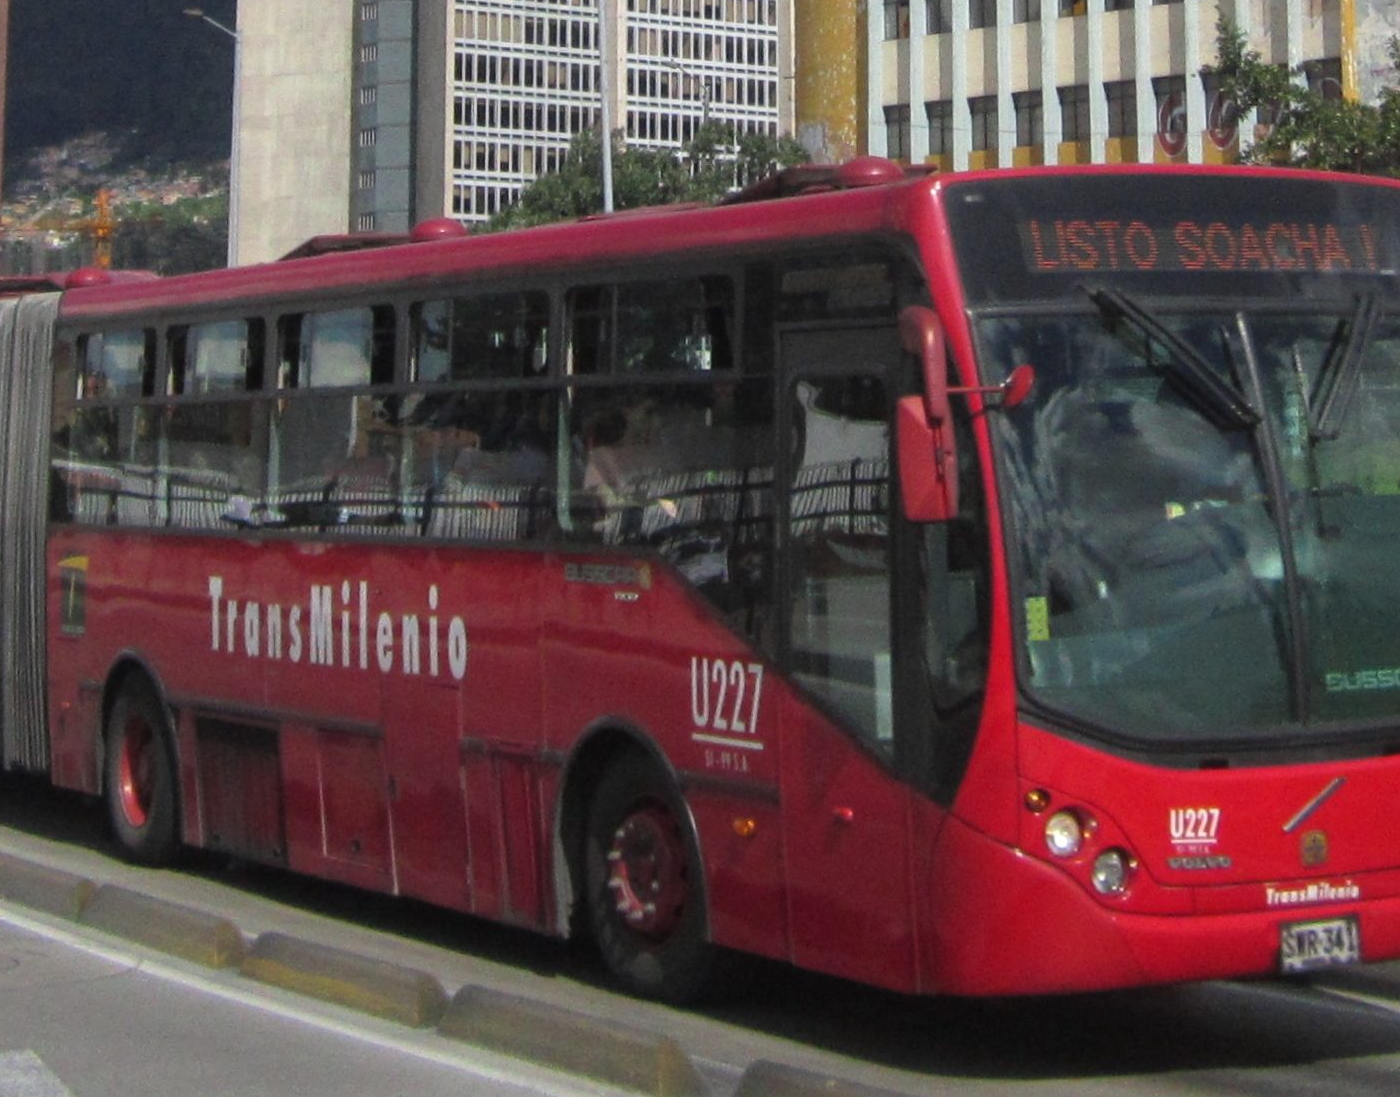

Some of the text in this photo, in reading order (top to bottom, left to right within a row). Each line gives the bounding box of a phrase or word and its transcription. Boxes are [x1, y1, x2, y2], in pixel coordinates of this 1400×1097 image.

[1030, 220, 1159, 271] LISTO
[1174, 221, 1351, 271] SOACHA
[208, 576, 468, 680] TransMilenio
[691, 656, 764, 734] U227
[1169, 807, 1220, 838] U227
[1265, 880, 1360, 905] TransMilenio
